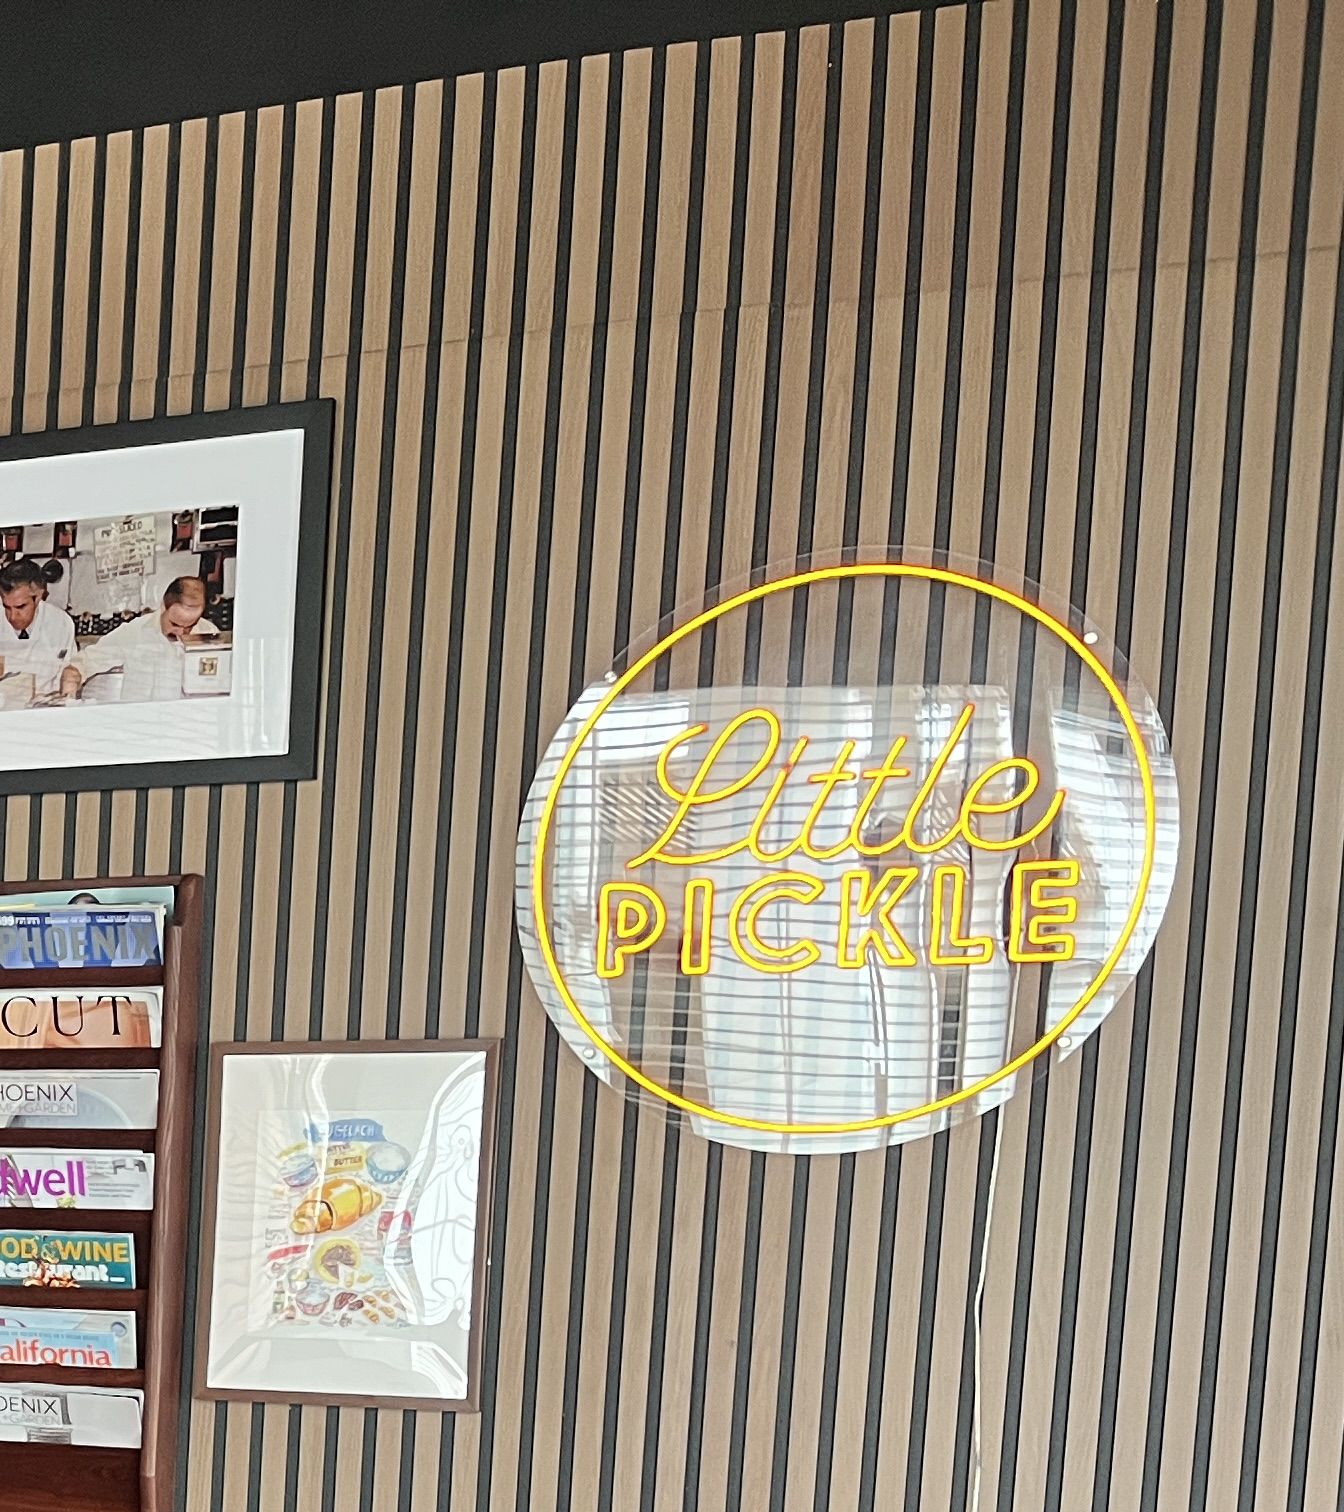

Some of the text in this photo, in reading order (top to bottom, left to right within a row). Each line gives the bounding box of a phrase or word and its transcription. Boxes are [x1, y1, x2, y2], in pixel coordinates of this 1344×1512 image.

[627, 705, 1066, 868] Little
[596, 859, 1080, 979] PICKLE
[1, 995, 132, 1038] CUT
[56, 1240, 130, 1263] WINE
